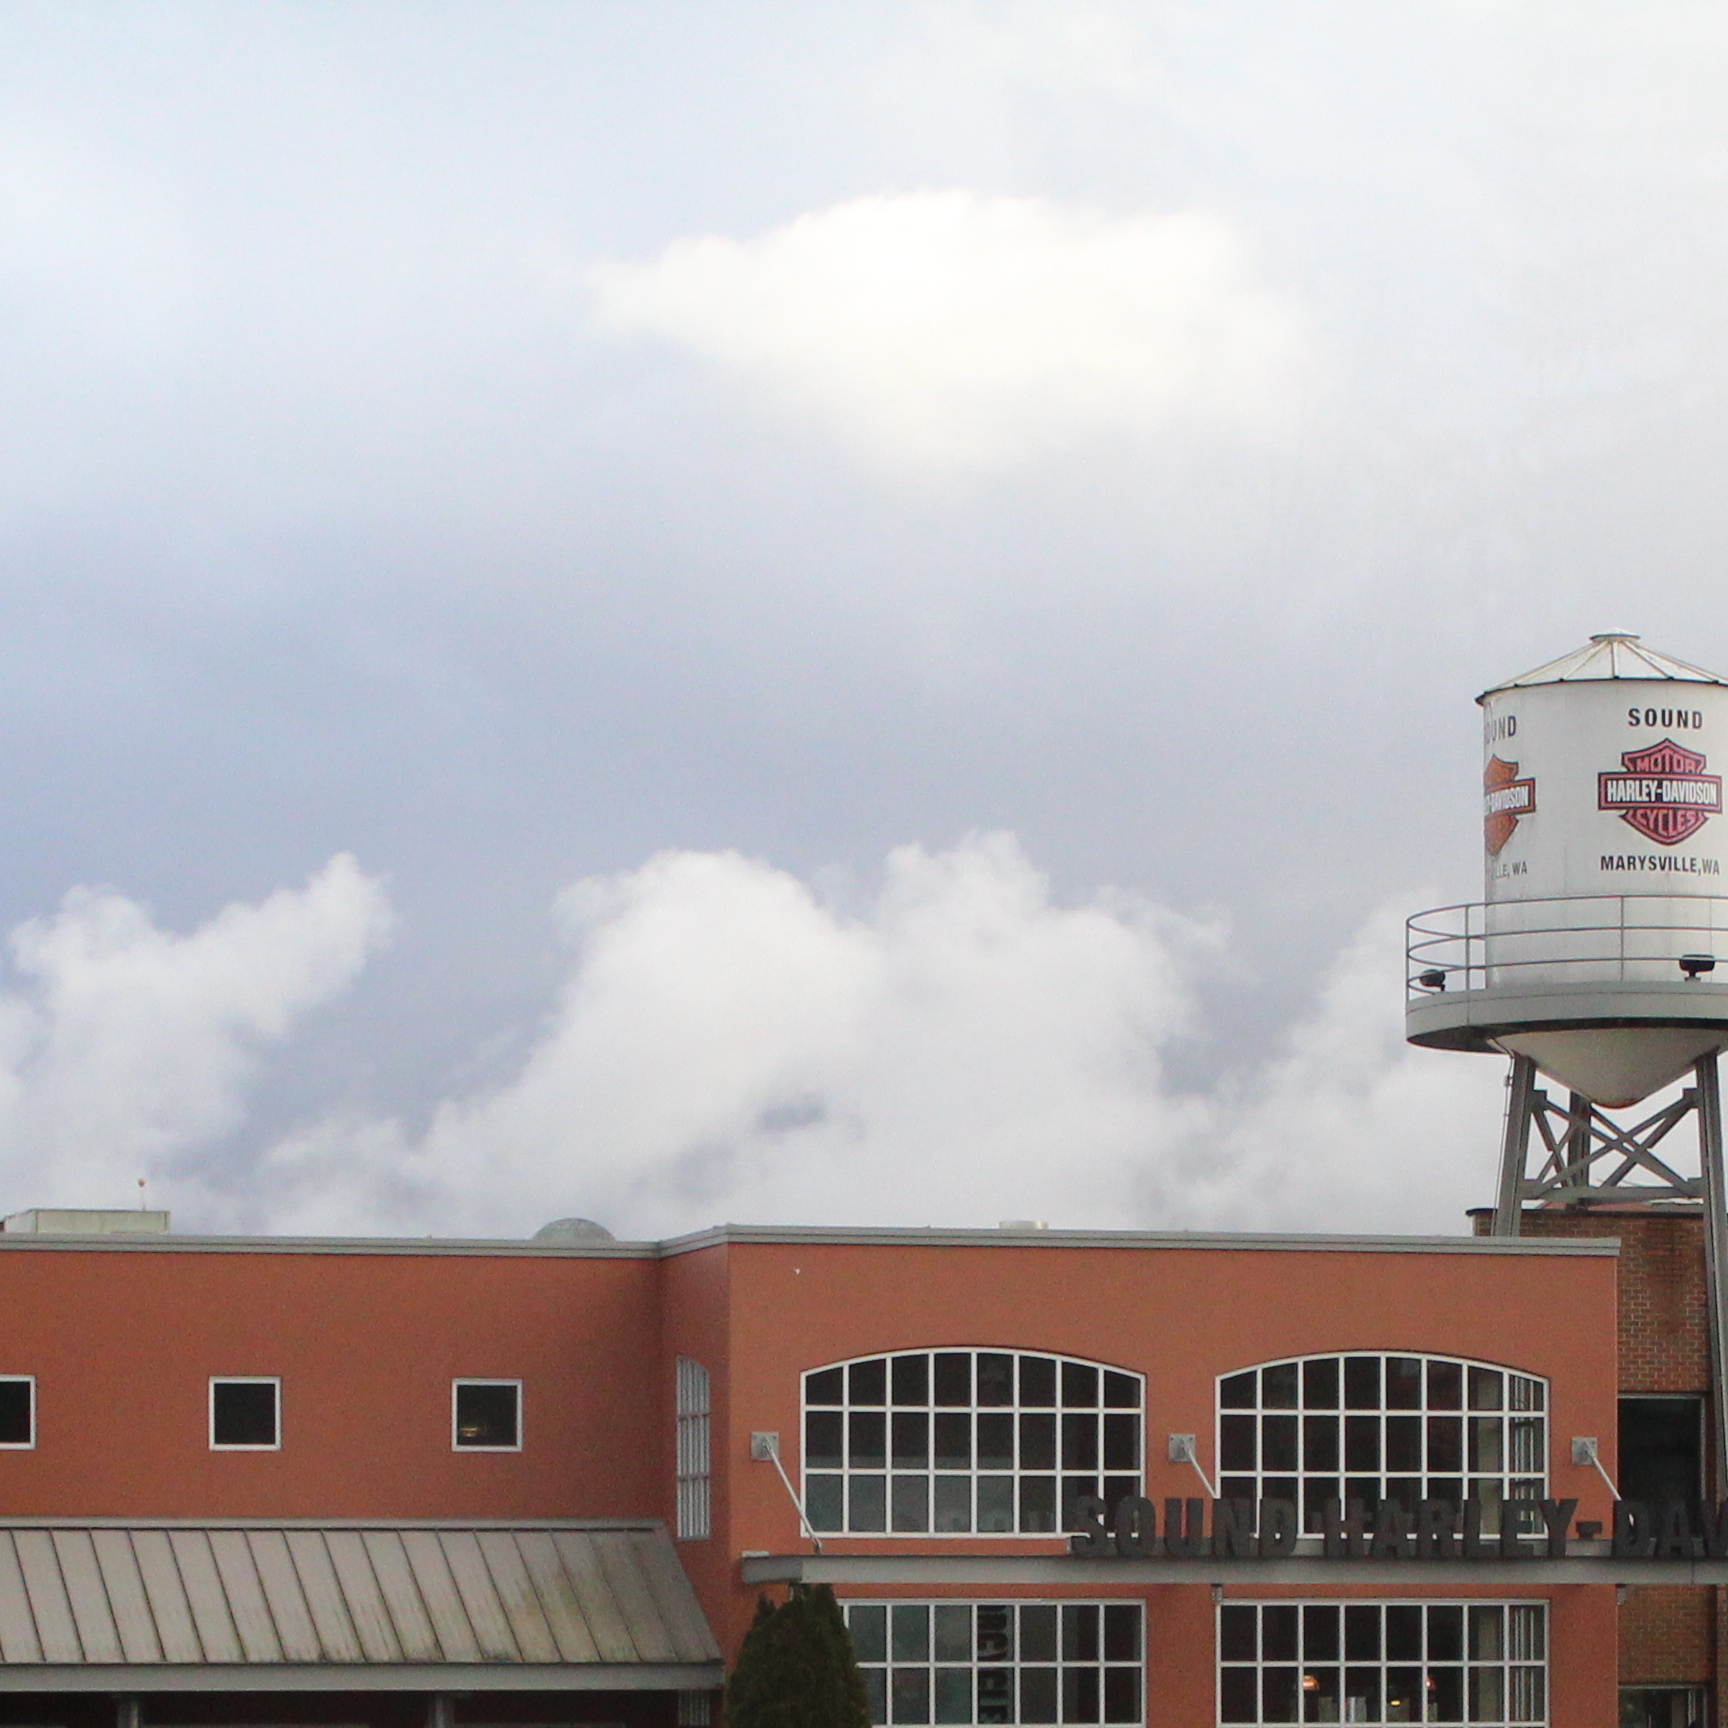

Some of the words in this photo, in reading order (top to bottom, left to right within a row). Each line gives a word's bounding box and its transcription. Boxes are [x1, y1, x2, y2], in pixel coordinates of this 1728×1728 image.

[1486, 716, 1517, 744] OUND
[1628, 708, 1703, 729] SOUND
[1635, 749, 1697, 775] MOTOR
[1607, 780, 1717, 805] HARLEY-DAVIDSON
[1635, 808, 1696, 837] CYCLES
[1068, 1497, 1298, 1558] SOUND
